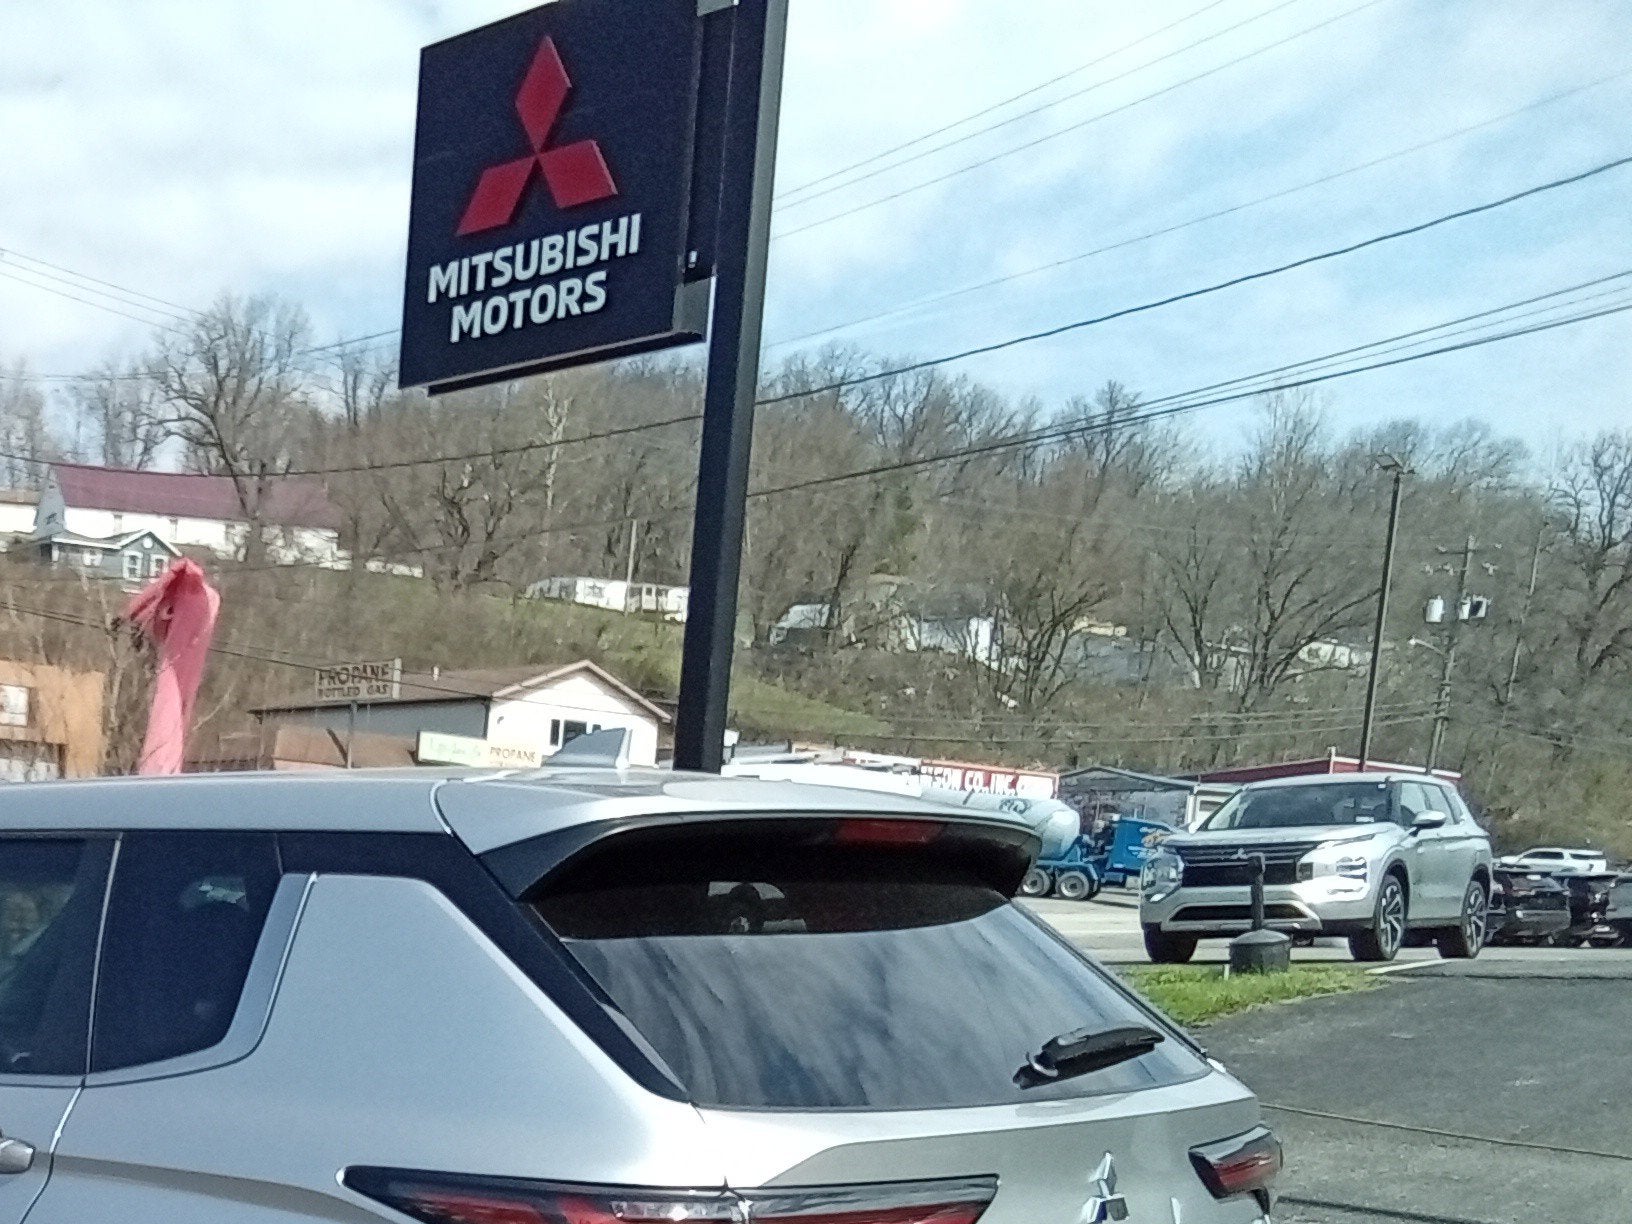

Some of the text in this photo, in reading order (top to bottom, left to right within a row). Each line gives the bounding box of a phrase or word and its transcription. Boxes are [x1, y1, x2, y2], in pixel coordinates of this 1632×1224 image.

[427, 213, 641, 303] MITSUBISHI
[450, 270, 607, 343] MOTORS
[318, 663, 389, 686] PROPANE
